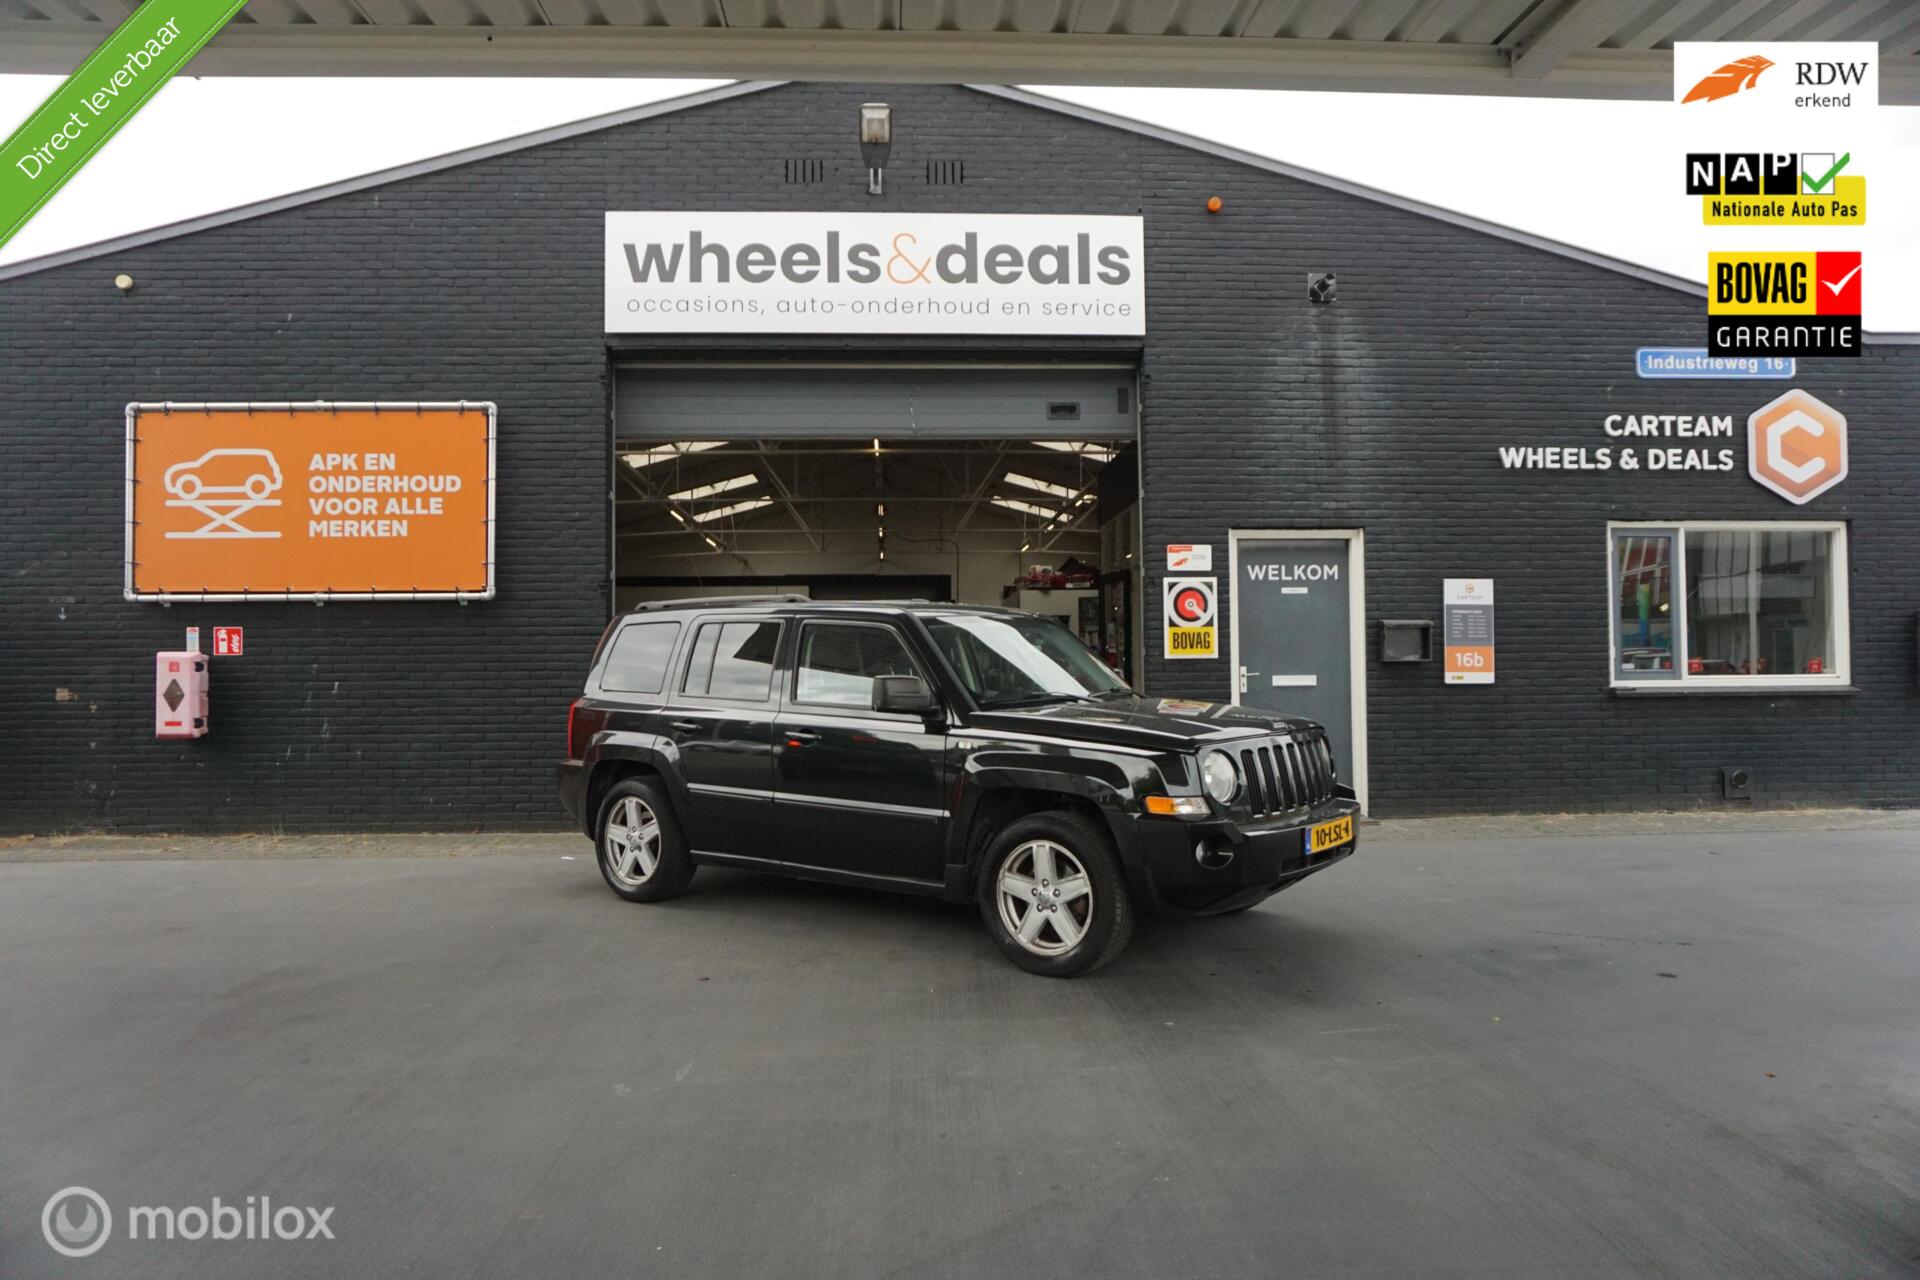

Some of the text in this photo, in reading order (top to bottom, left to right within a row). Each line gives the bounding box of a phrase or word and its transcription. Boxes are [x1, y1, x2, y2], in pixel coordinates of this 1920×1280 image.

[623, 230, 1131, 285] wheels&deals
[627, 295, 1132, 317] occasions, auto-onderhoud en service
[1648, 354, 1783, 373] Industrieweg 16
[1604, 414, 1733, 437] CARTEAM
[308, 453, 396, 471] APK EN
[1499, 447, 1734, 471] WHEELS & DEALS
[308, 475, 462, 493] ONDERHOUD
[308, 497, 443, 515] VOOR ALLE
[308, 519, 408, 537] MERKEN
[1247, 564, 1339, 581] WELKOM
[1173, 632, 1211, 650] BOVAG
[1455, 652, 1484, 668] 16b
